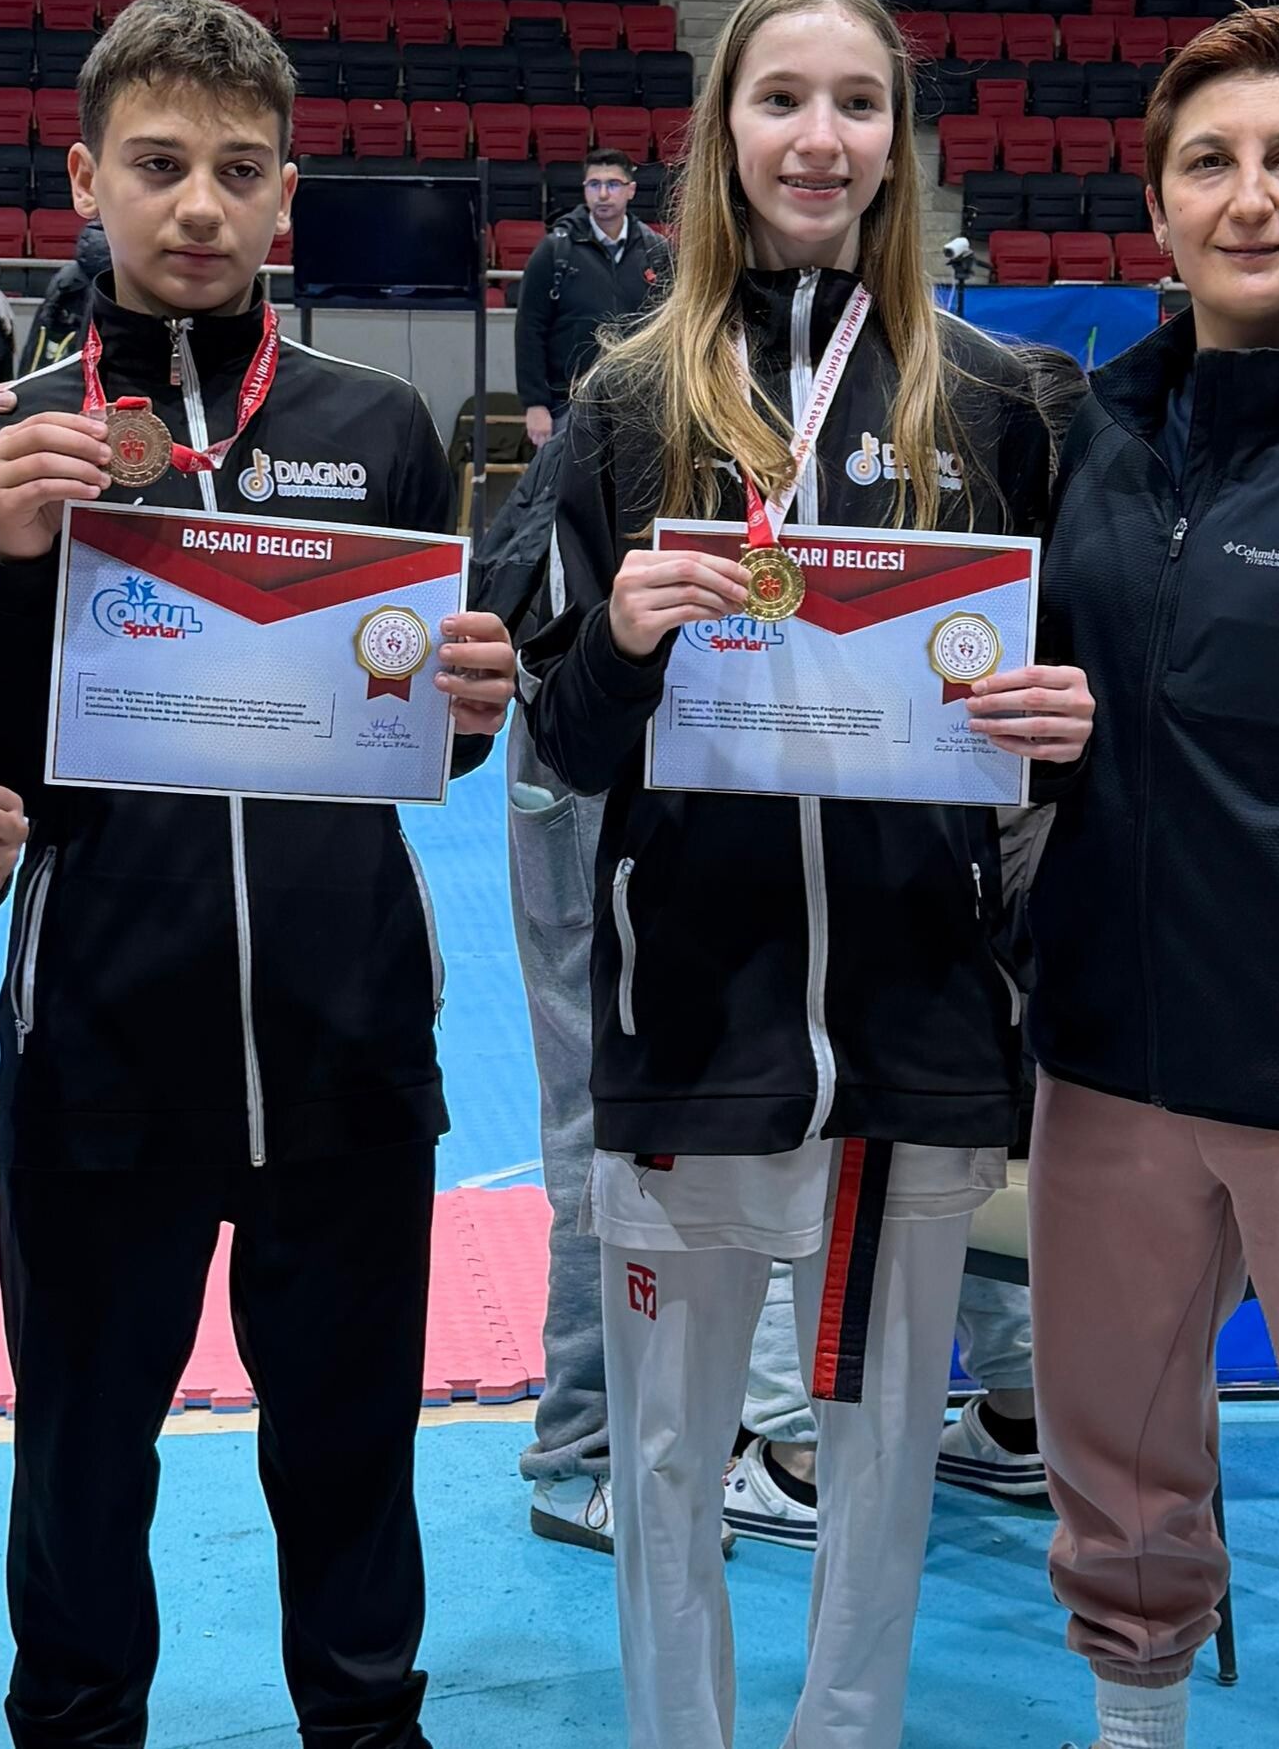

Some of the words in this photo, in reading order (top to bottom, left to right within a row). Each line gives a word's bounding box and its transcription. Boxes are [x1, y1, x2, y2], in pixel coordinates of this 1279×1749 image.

[274, 460, 367, 487] DIAGNO
[181, 528, 252, 555] BAŞARI
[256, 534, 333, 561] BELGESİ
[832, 549, 905, 571] BELGESİ
